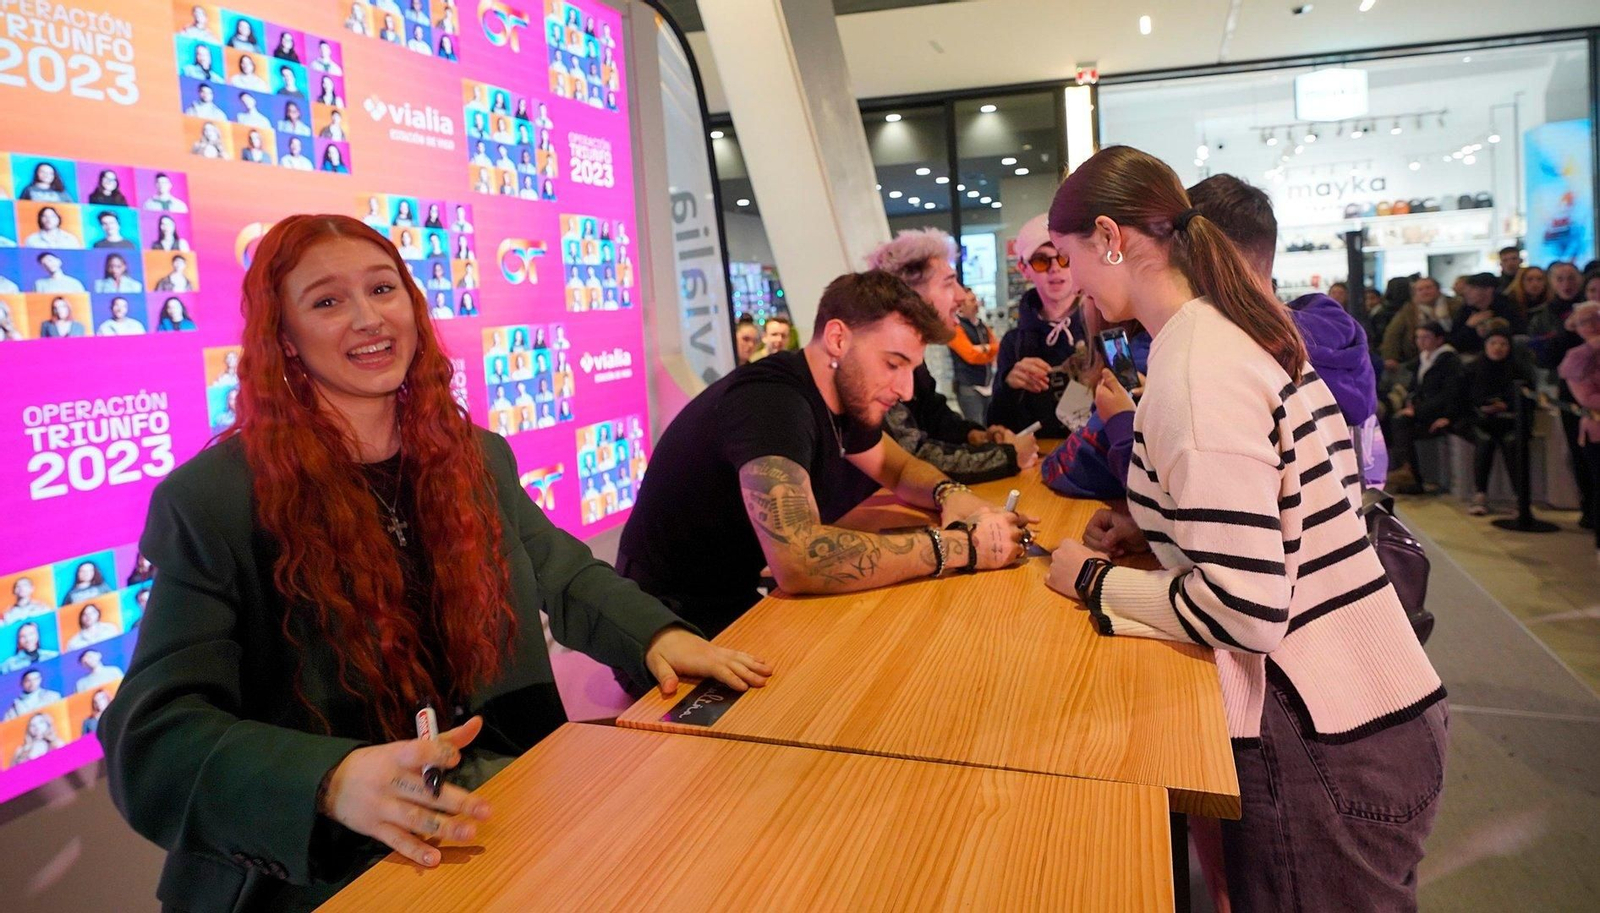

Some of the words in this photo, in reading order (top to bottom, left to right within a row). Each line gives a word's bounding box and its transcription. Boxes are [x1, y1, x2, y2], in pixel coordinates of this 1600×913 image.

[0, 0, 133, 39] ERACIÓN
[0, 10, 135, 62] RIUNFO
[0, 37, 140, 106] 2023
[387, 102, 454, 136] vialia
[570, 157, 615, 188] 2023
[1287, 175, 1387, 200] mayka
[22, 389, 168, 427] OPERACIÓN
[24, 410, 170, 452] TRIUNFO
[27, 433, 175, 501] 2023
